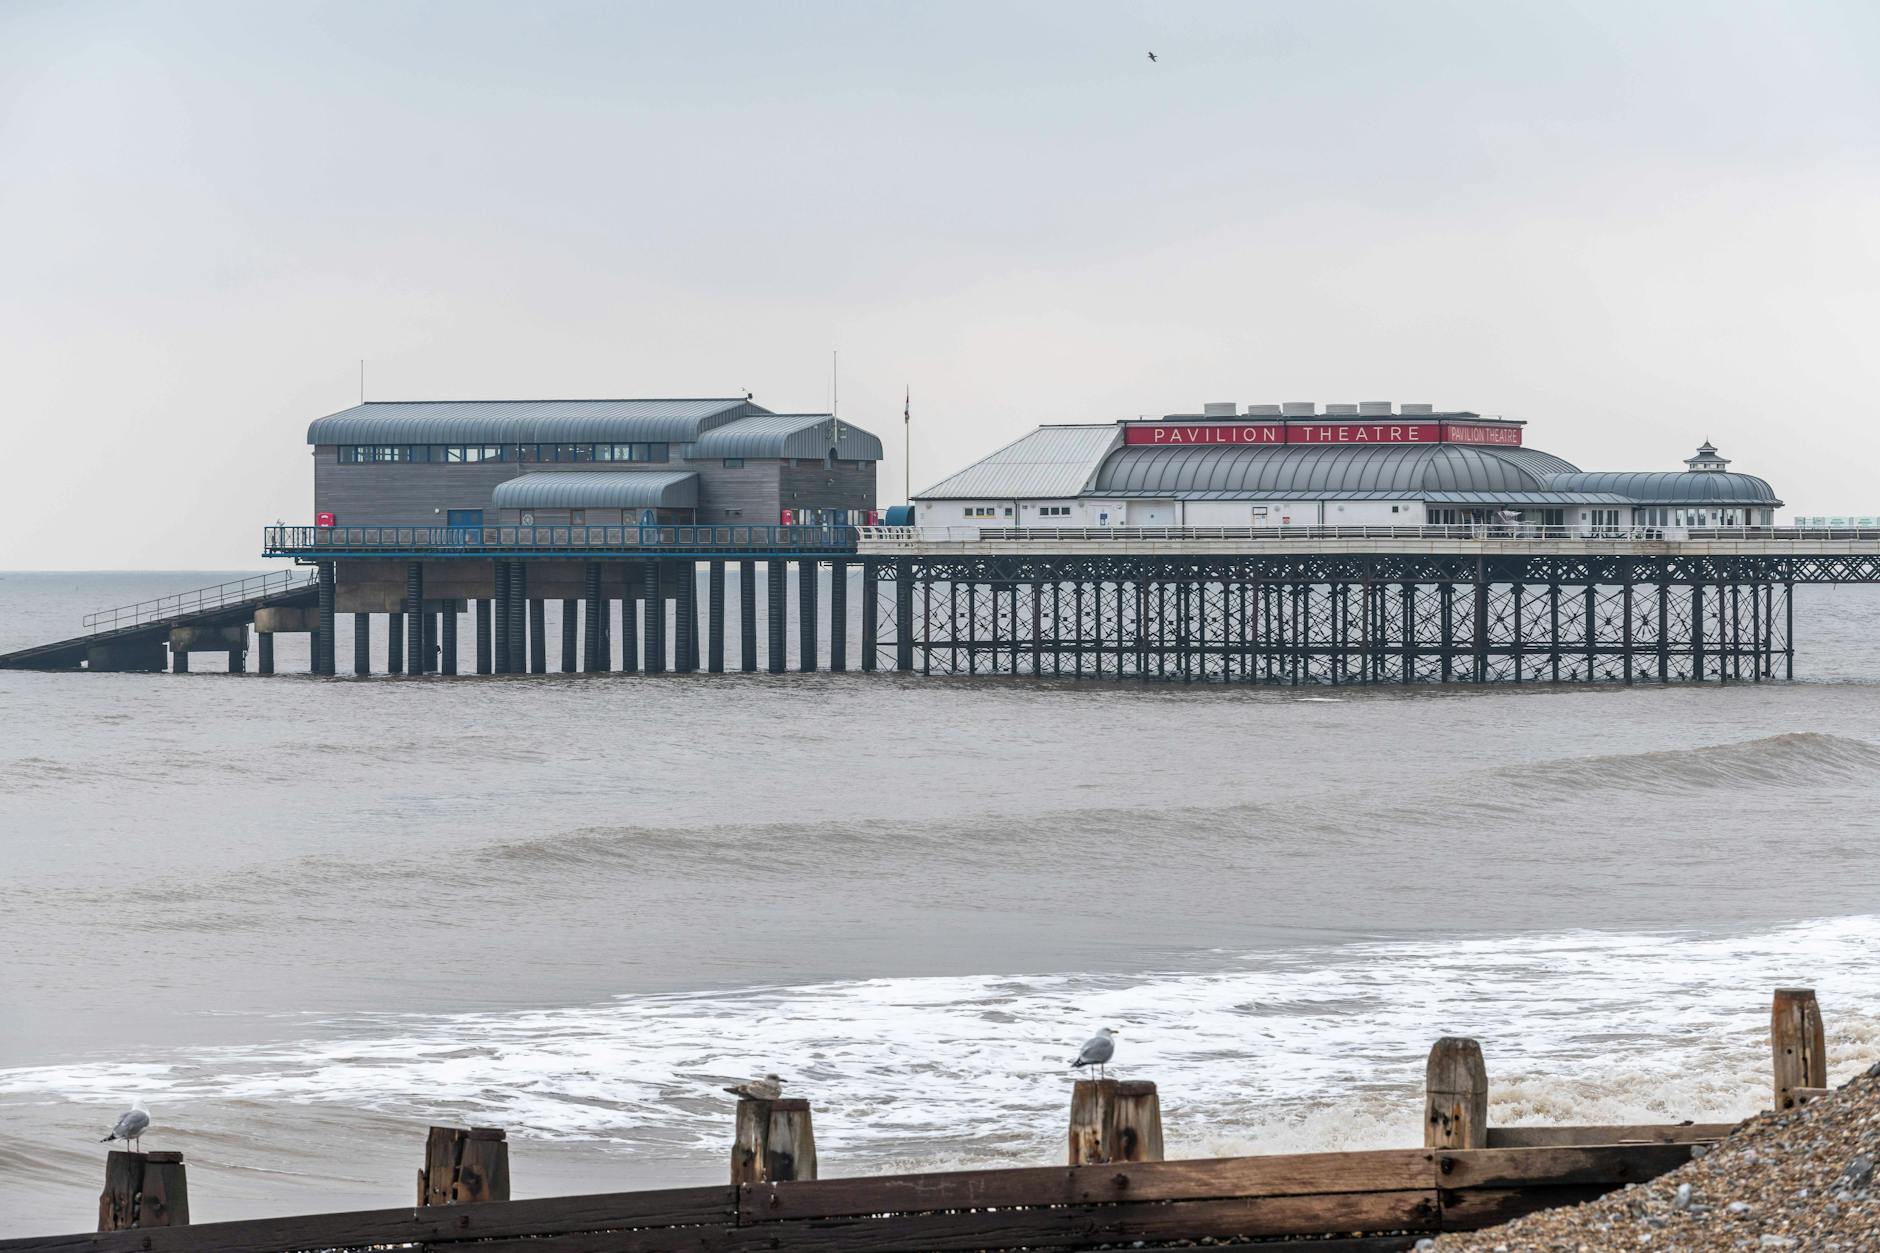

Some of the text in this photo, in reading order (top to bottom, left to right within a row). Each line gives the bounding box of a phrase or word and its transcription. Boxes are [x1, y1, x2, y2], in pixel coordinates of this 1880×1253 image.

[1154, 426, 1419, 442] PAVILION THEATRE
[1451, 427, 1518, 443] PAVILION THEATRE
